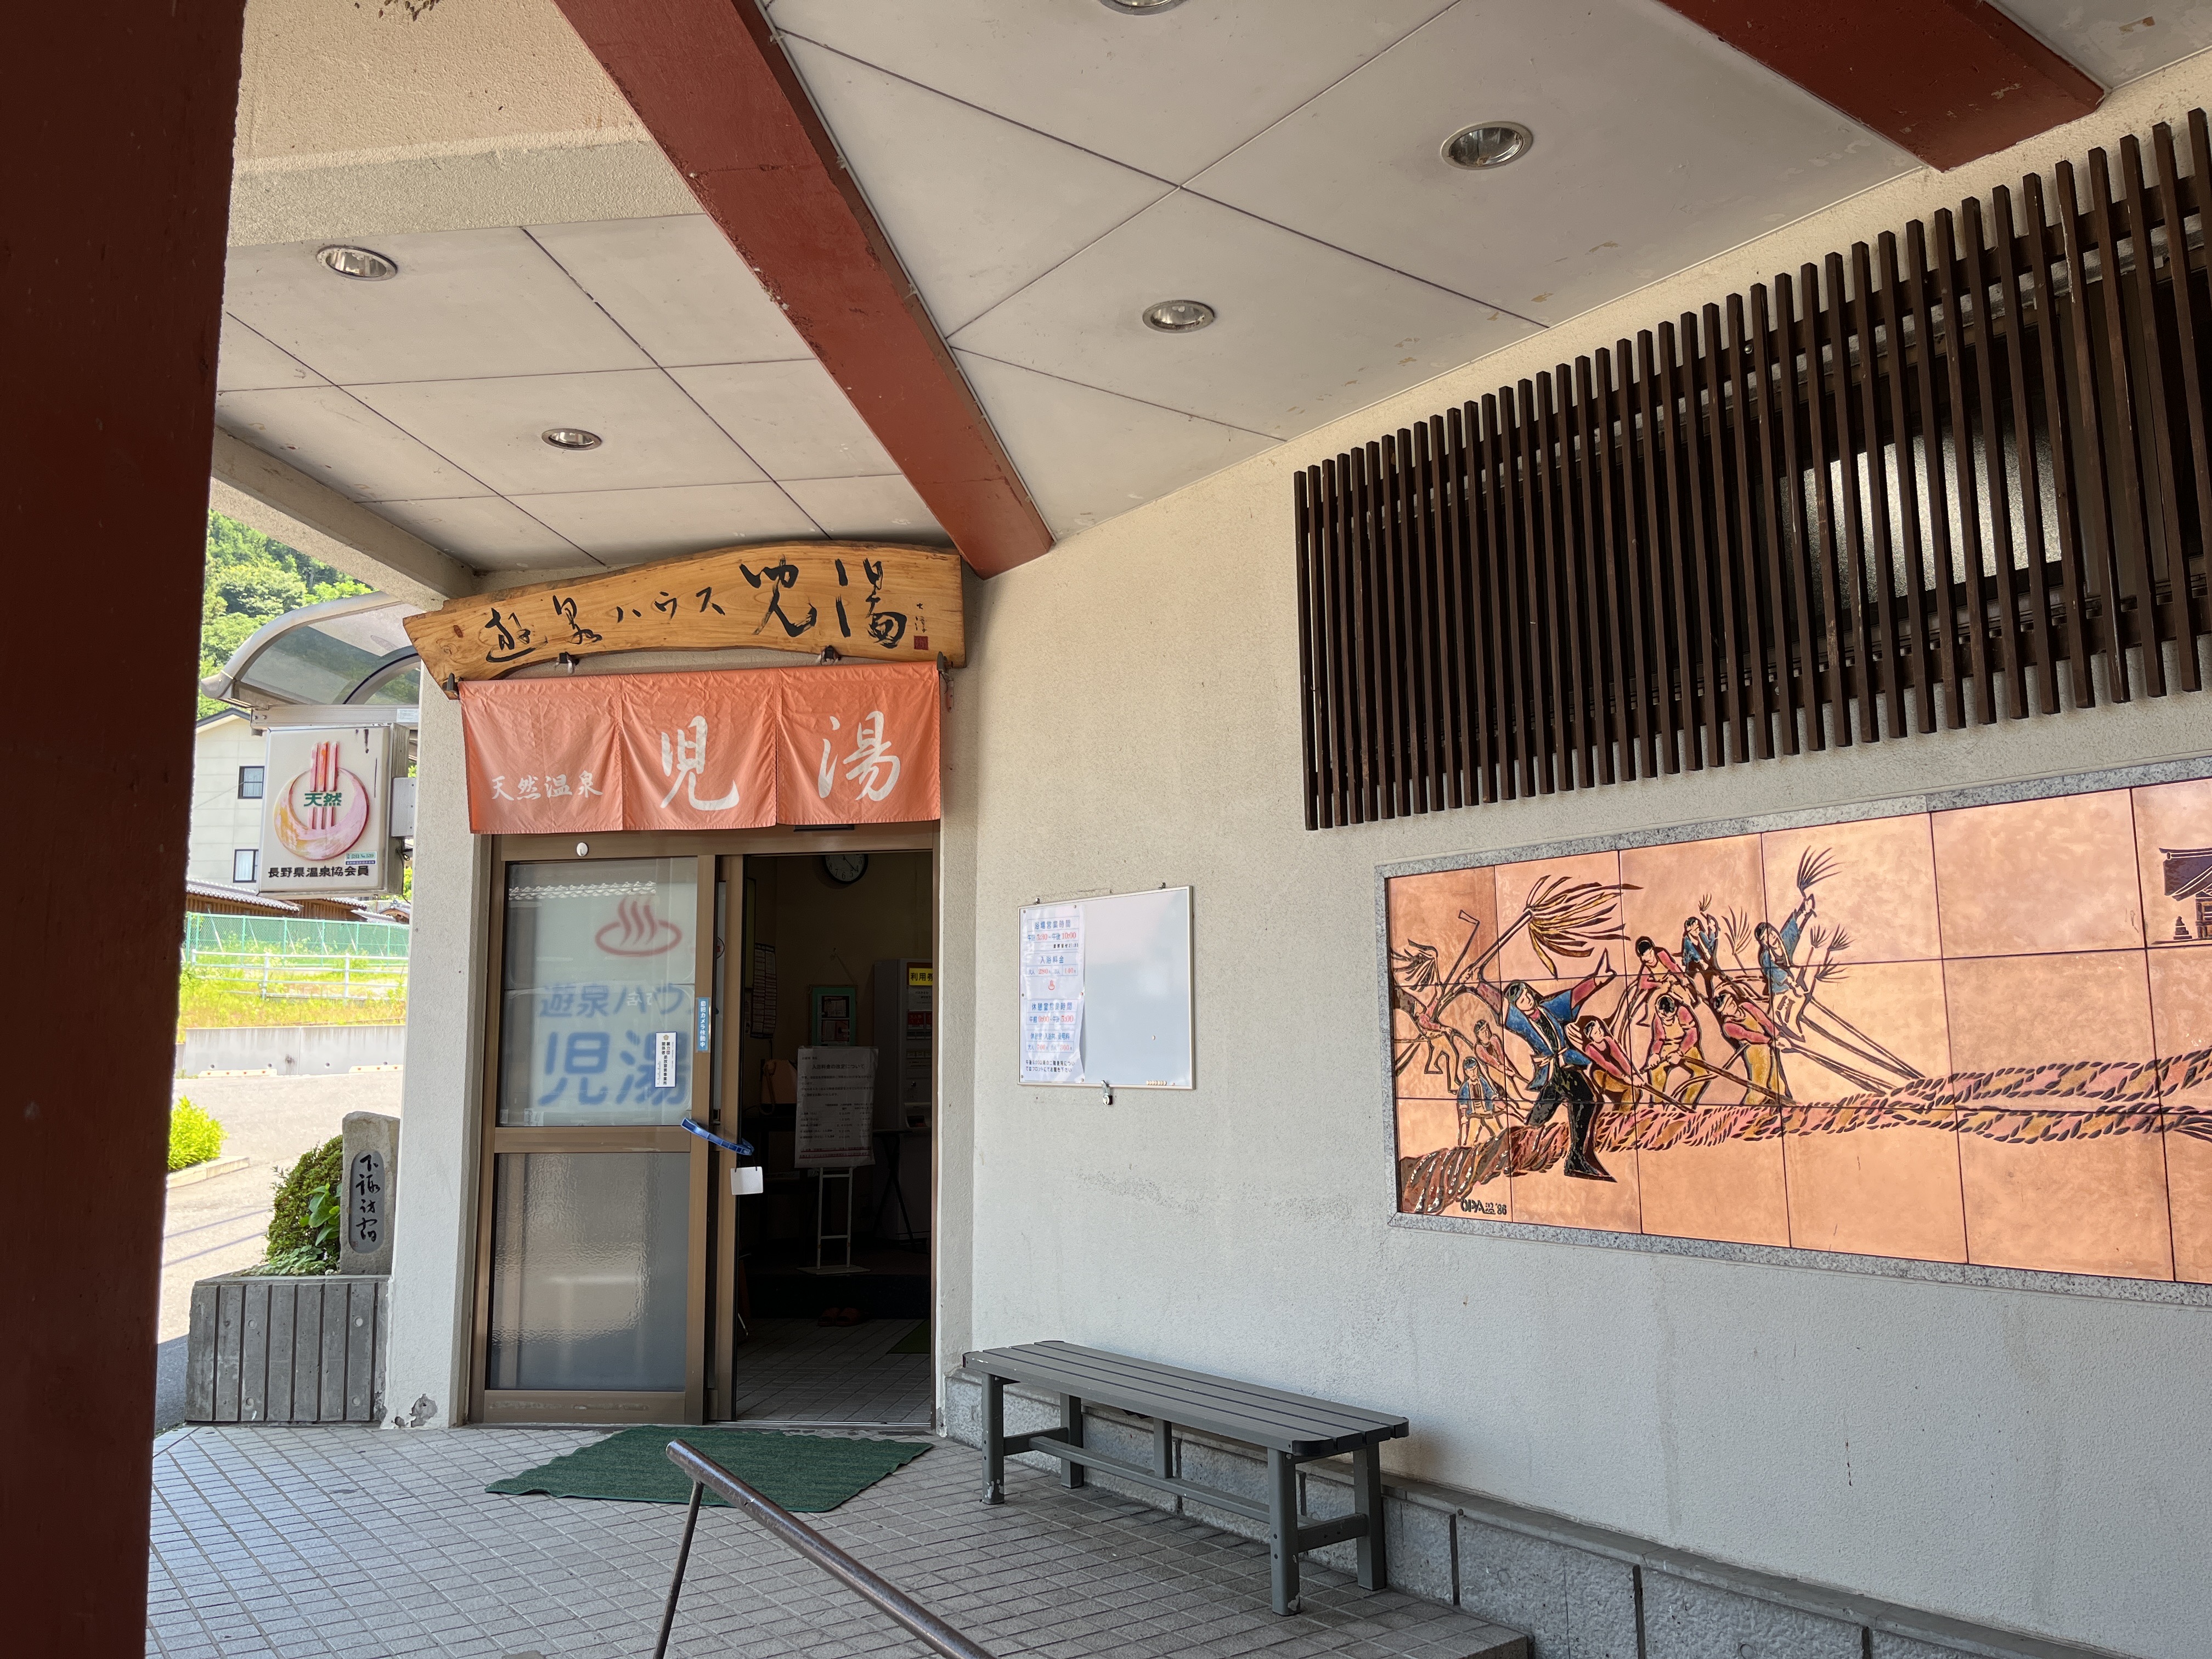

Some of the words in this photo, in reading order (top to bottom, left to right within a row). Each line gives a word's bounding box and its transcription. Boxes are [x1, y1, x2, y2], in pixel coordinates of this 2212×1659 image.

[490, 770, 603, 802] 天然温泉
[303, 792, 342, 807] 天然
[268, 865, 369, 878] 長野県温泉協会員
[1040, 955, 1064, 964] 入浴料金
[539, 983, 693, 1018] 遊泉ハウ
[538, 1029, 689, 1106] 児湯
